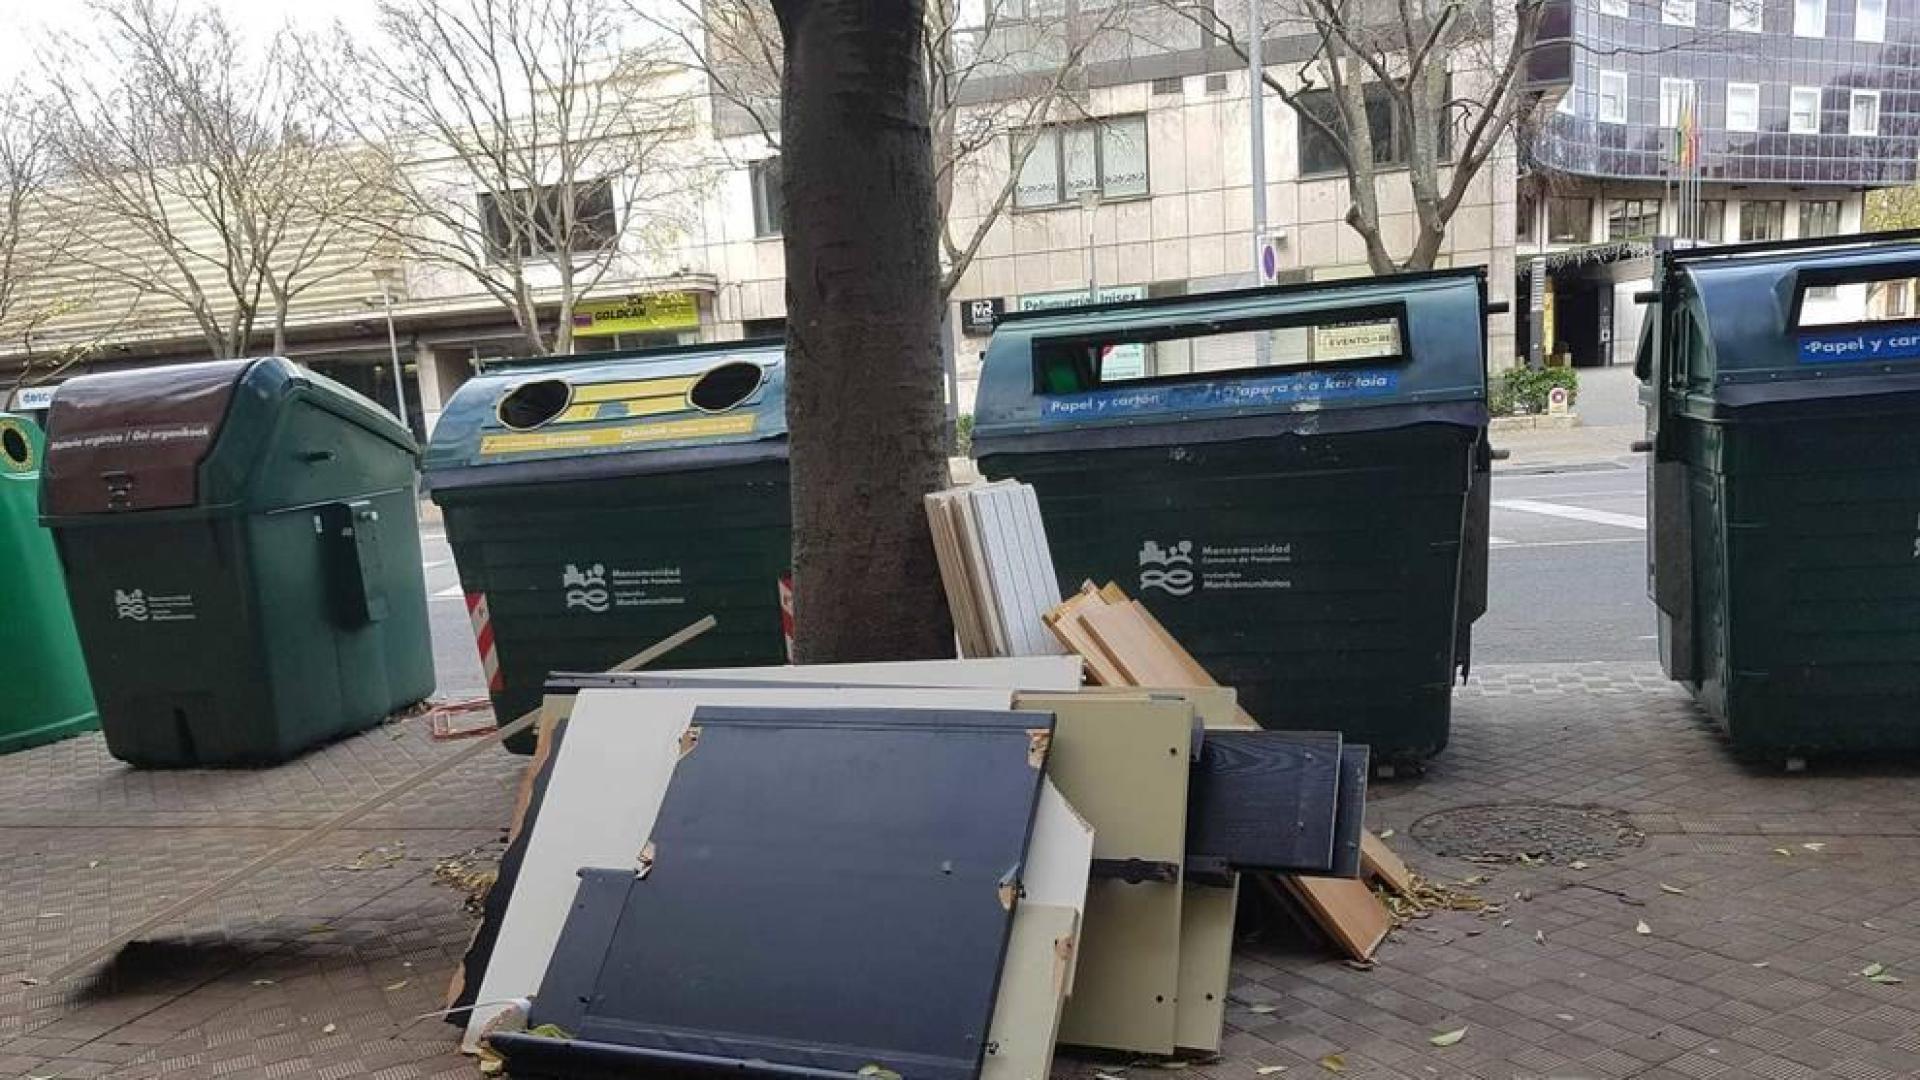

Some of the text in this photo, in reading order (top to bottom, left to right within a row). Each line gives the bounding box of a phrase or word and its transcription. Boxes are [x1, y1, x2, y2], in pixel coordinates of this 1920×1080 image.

[1869, 339, 1882, 352] y
[1051, 398, 1093, 413] Papel
[1097, 400, 1107, 411] y
